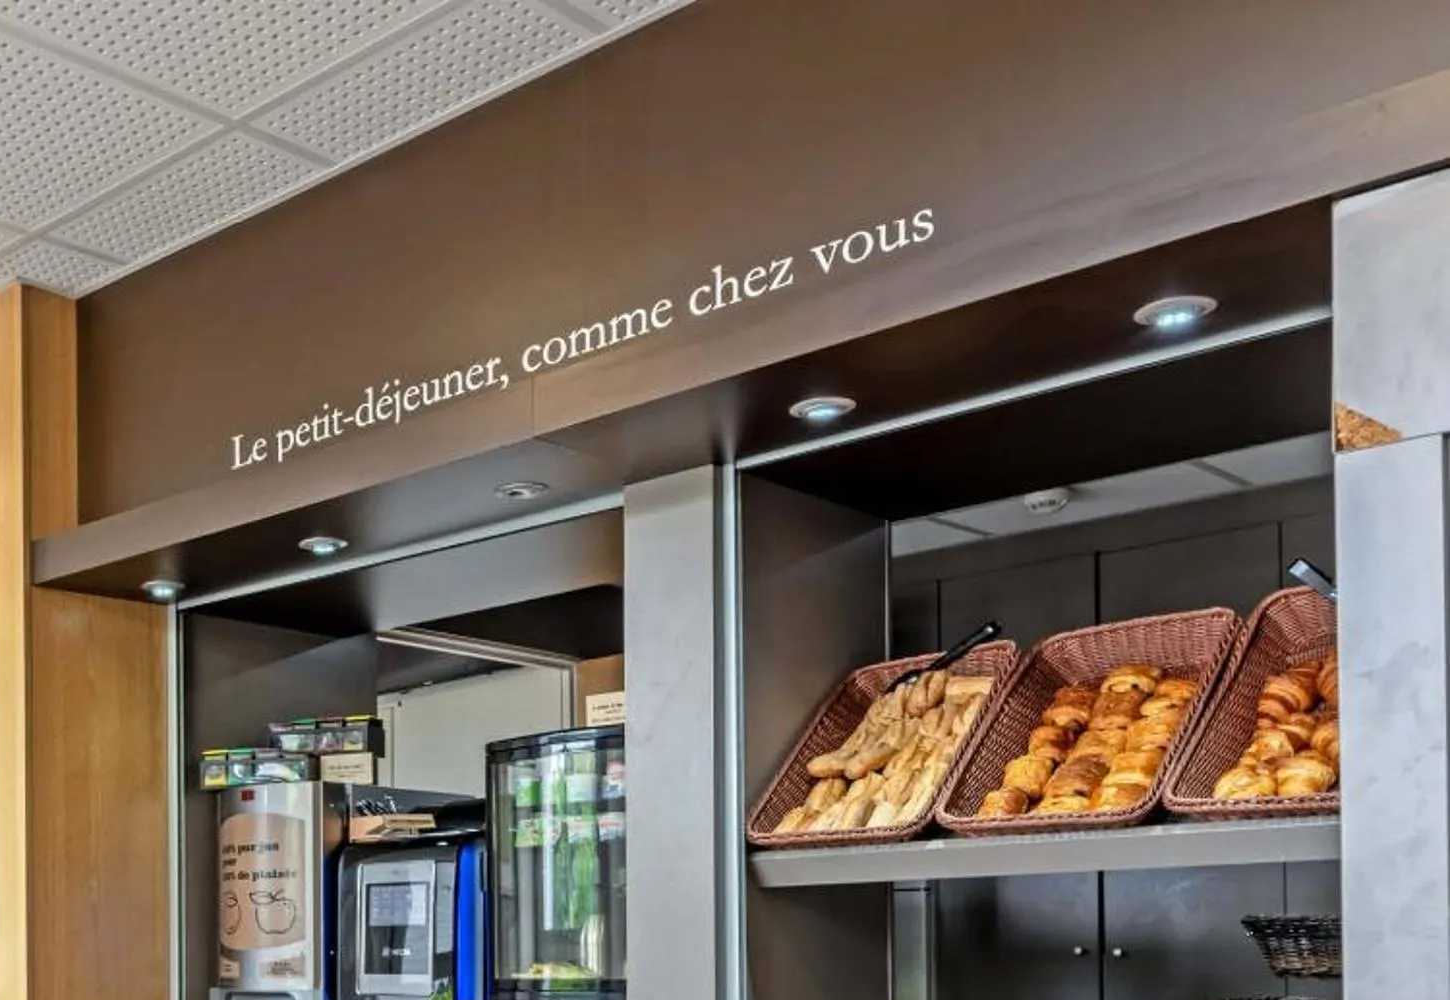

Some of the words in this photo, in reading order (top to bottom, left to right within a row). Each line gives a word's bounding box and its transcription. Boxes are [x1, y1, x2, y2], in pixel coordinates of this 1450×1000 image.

[231, 430, 269, 470] Le
[274, 357, 510, 463] petit-déjeuner,
[521, 298, 673, 373] comme
[688, 256, 794, 316] chez
[809, 208, 936, 275] vous
